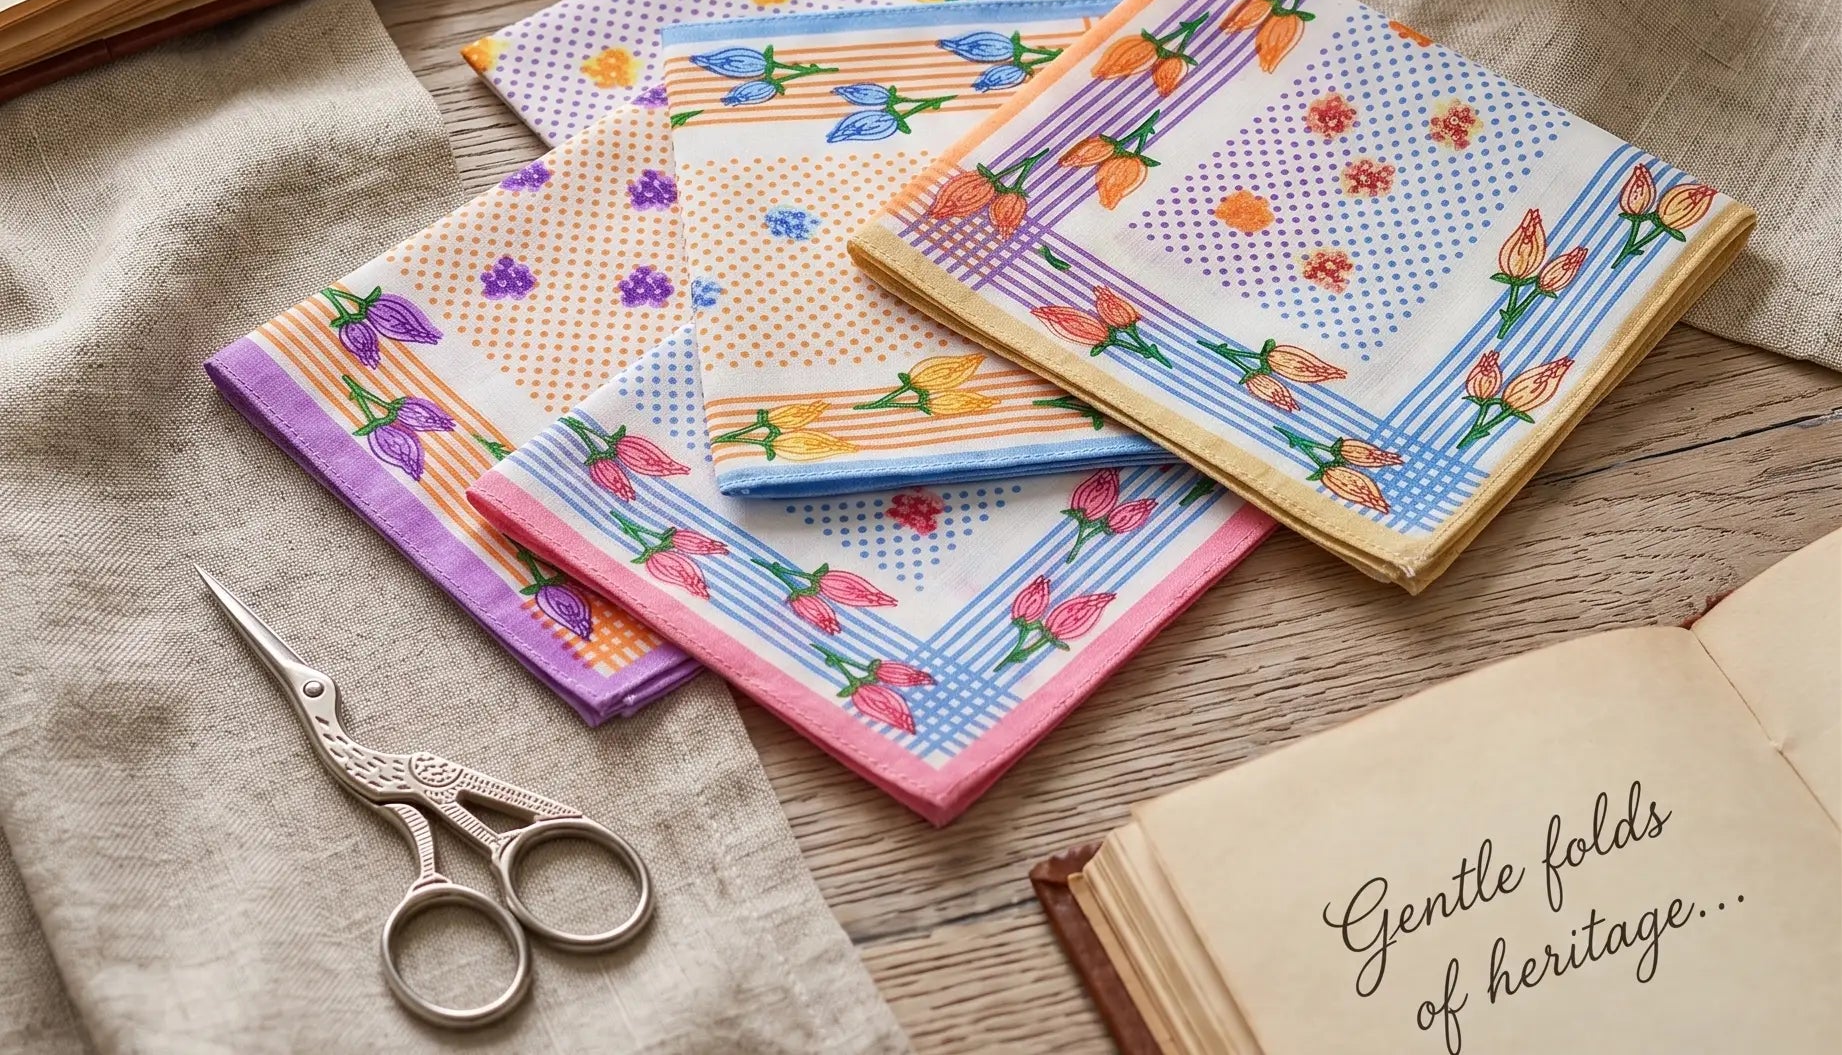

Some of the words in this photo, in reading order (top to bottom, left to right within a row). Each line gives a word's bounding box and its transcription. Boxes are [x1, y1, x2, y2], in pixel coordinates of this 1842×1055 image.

[1322, 838, 1526, 998] Gentle
[1541, 780, 1673, 913] folds
[1416, 957, 1469, 1055] of
[1487, 894, 1745, 1004] heritage...
